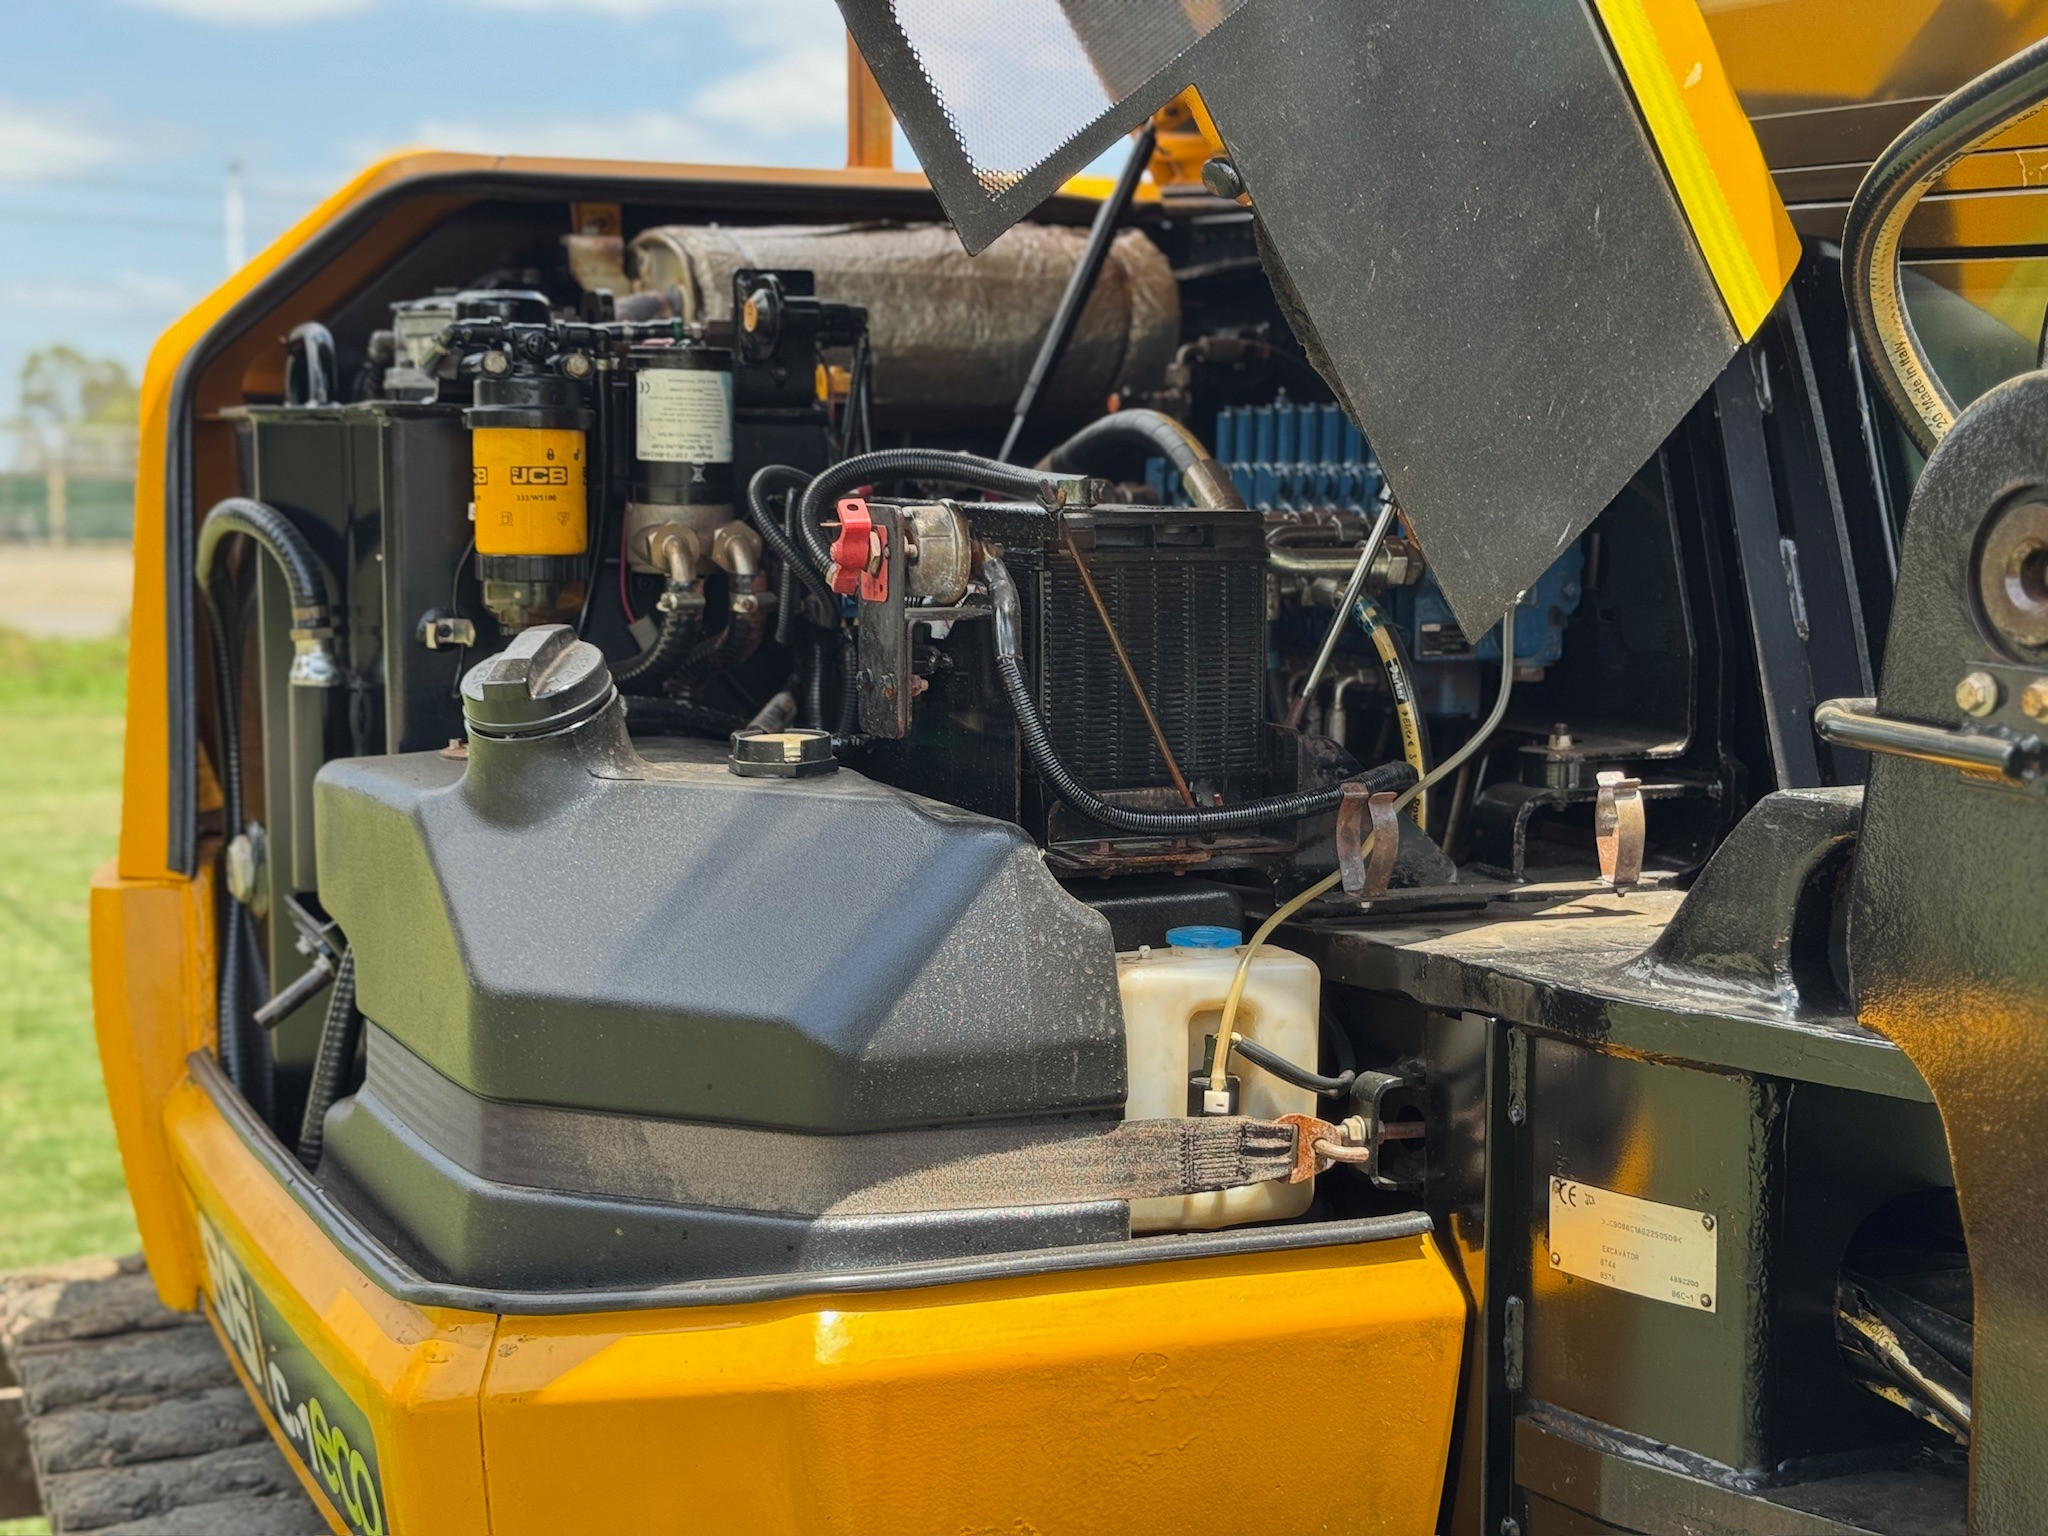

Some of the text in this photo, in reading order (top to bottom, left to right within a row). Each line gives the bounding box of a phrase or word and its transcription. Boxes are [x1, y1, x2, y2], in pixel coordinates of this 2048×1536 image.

[1894, 339, 1913, 365] Italy
[1906, 364, 1920, 380] in
[1913, 379, 1937, 412] Made
[511, 467, 567, 485] JCB
[1388, 661, 1405, 701] Parker
[1556, 1181, 1577, 1208] CE
[1601, 1245, 1640, 1262] EXCAVATOR
[1671, 1289, 1695, 1303] 86C-1
